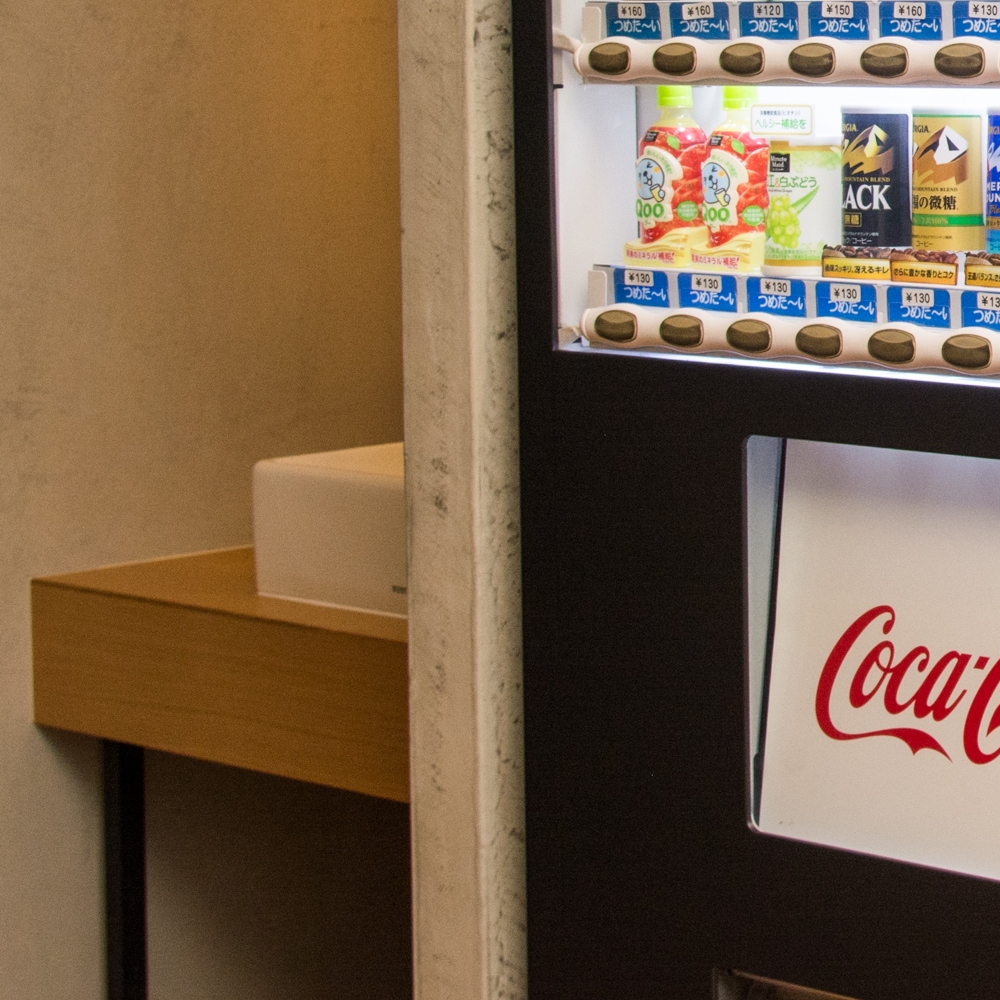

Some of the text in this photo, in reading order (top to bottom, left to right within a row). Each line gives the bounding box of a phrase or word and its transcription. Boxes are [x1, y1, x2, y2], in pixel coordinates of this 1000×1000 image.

[620, 5, 643, 17] ¥160
[687, 4, 711, 17] ¥160
[756, 4, 781, 16] ¥120
[826, 4, 850, 16] ¥150
[898, 4, 923, 17] ¥160
[973, 4, 998, 16] ¥130
[755, 118, 807, 130] ヘルシー補給を
[628, 272, 651, 284] ¥130
[893, 267, 954, 280] さらに豊かな香りとコク
[695, 277, 719, 289] ¥130
[764, 281, 788, 293] ¥130
[833, 287, 857, 299] ¥130
[905, 292, 931, 303] ¥130
